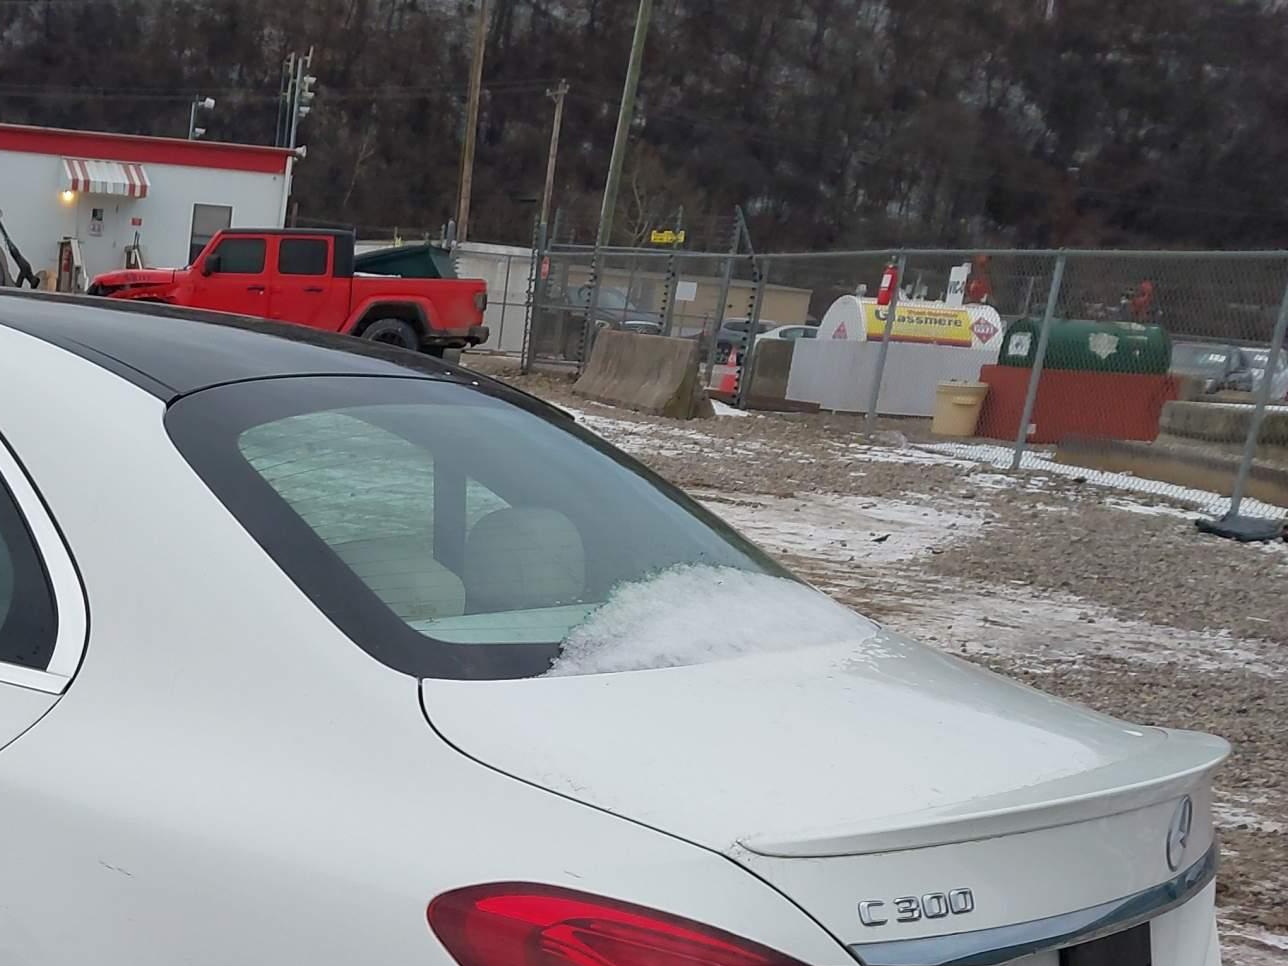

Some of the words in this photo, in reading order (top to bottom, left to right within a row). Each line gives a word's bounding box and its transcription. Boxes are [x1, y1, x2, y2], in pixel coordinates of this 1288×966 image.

[874, 308, 963, 327] Gassmere
[857, 899, 889, 927] C
[893, 887, 975, 923] 300
